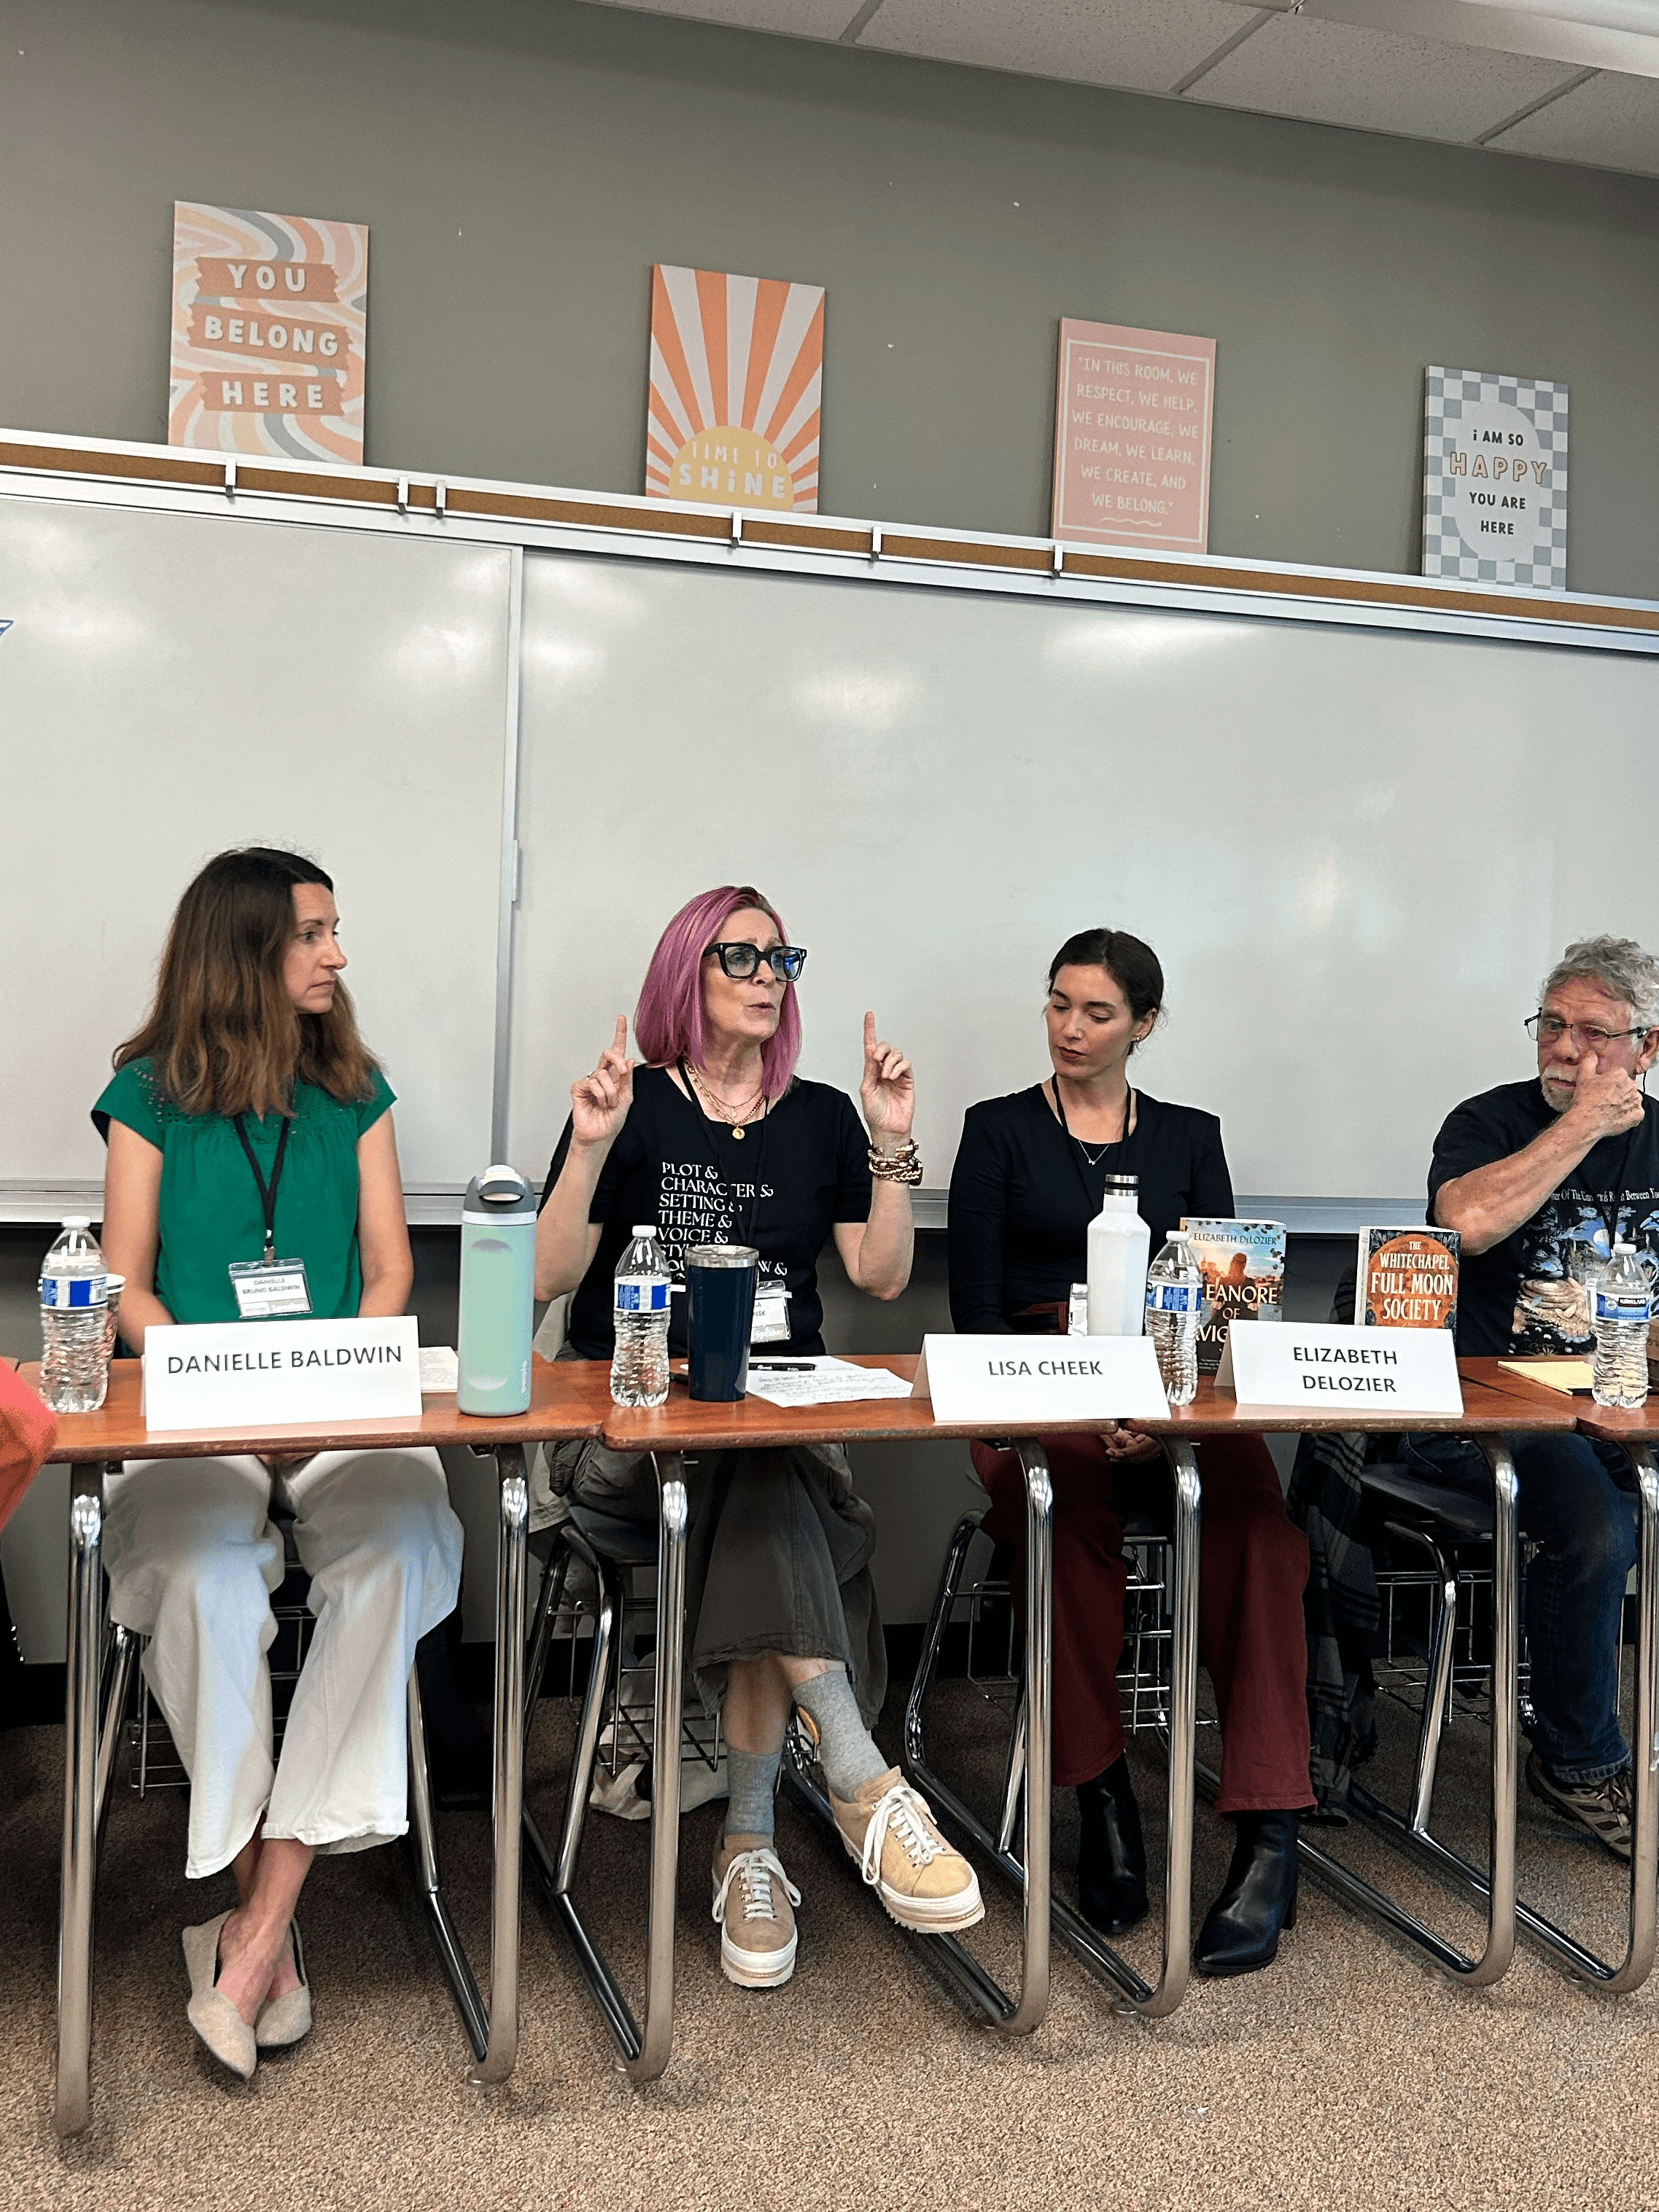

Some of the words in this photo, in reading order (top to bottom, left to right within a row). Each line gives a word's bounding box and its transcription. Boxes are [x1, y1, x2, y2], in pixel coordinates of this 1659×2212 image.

[227, 264, 306, 292] YOU
[203, 315, 339, 357] BELONG
[1078, 357, 1100, 373] "IN
[1106, 360, 1130, 376] THIS
[1178, 370, 1198, 386] WE
[221, 380, 324, 409] HERE
[1138, 391, 1159, 407] WE
[1072, 410, 1092, 424] WE
[1178, 423, 1199, 439] WE
[1483, 430, 1502, 444] AM
[1508, 433, 1523, 446] SO
[692, 441, 739, 465] TIME
[754, 449, 778, 470] TO
[1125, 444, 1146, 459] WE
[1081, 464, 1101, 479] WE
[1161, 475, 1186, 490] AND
[1450, 451, 1547, 485] HAPPY
[1092, 492, 1112, 507] WE
[1469, 491, 1496, 506] YOU
[1501, 496, 1526, 510] ARE
[1480, 520, 1514, 535] HERE
[662, 1161, 702, 1177] PLOT
[704, 1166, 718, 1180] &
[760, 1184, 774, 1198] &
[1561, 1188, 1570, 1200] Of
[1571, 1188, 1581, 1201] The
[1625, 1190, 1650, 1201] Between
[659, 1193, 726, 1212] SETTING
[658, 1210, 715, 1228] THEME
[718, 1215, 733, 1228] &
[658, 1227, 710, 1243] VOICE
[714, 1231, 729, 1244] &
[1194, 1232, 1238, 1244] ELIZABETH
[1409, 1241, 1421, 1250] THE
[774, 1262, 788, 1276] &
[1379, 1253, 1450, 1270] WHITECHAPEL
[1370, 1272, 1406, 1294] FULL
[1411, 1273, 1453, 1296] MOON
[1222, 1307, 1240, 1320] OF
[1383, 1298, 1442, 1320] SOCIETY
[168, 1351, 282, 1374] DANIELLE
[292, 1345, 403, 1368] BALDWIN
[1293, 1347, 1397, 1365] ELIZABETH
[988, 1360, 1032, 1376] LISA
[1038, 1360, 1103, 1376] CHEEK
[1302, 1375, 1396, 1393] DELOZIER
